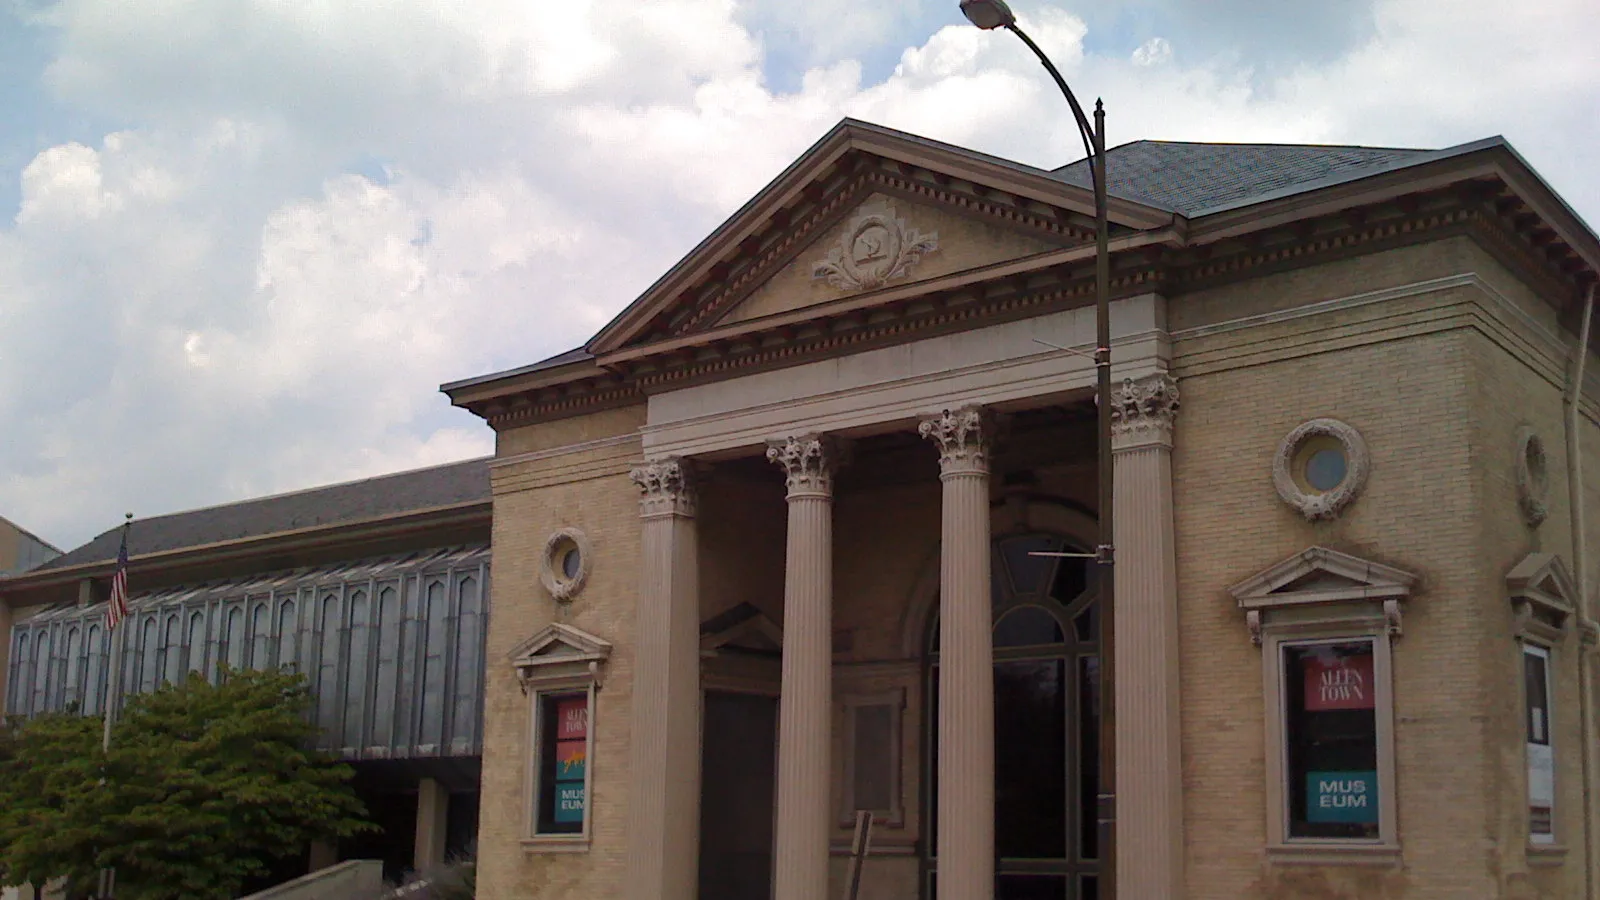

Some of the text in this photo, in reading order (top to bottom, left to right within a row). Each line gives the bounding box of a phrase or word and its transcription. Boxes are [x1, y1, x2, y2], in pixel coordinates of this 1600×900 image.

[1319, 668, 1363, 685] ALLEN
[1319, 685, 1364, 701] TOWN
[1320, 780, 1366, 793] MUS
[1320, 795, 1367, 807] EUM
